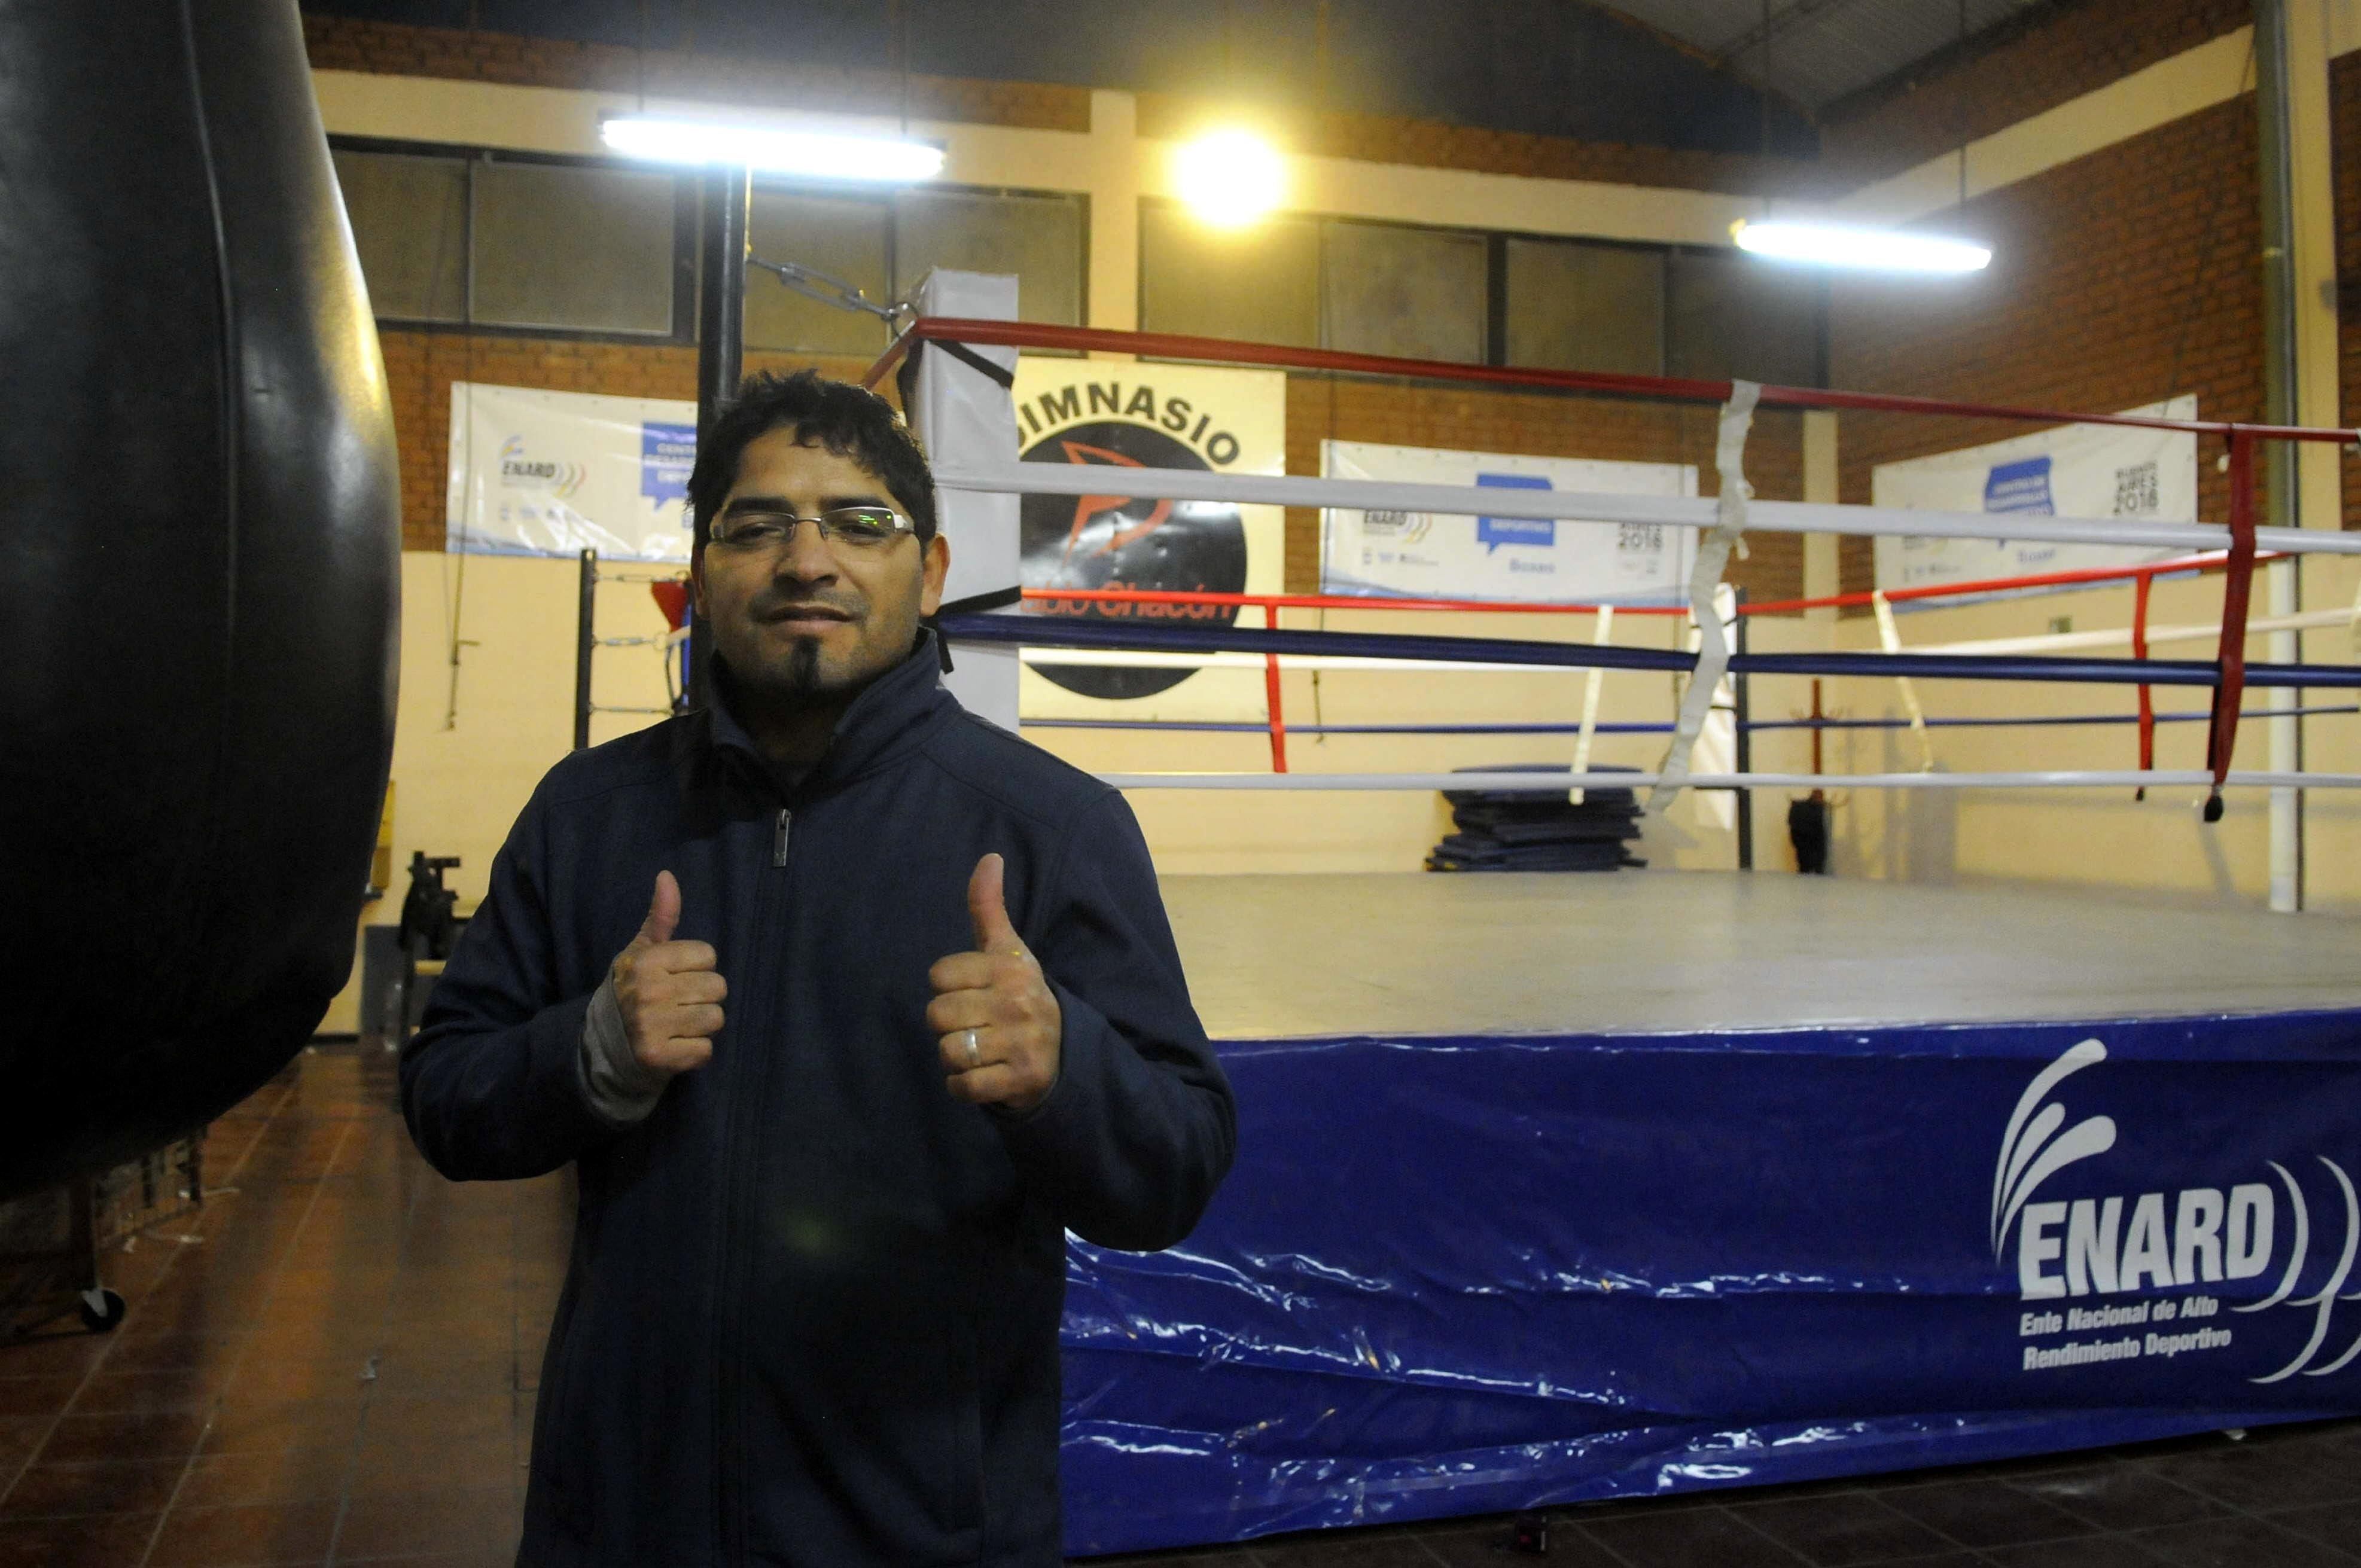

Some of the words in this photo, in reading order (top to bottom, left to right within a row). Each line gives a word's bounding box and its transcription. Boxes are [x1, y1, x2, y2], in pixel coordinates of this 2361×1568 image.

[1017, 381, 1241, 465] IMNASIO
[503, 460, 555, 478] ENARD
[2019, 1183, 2274, 1301] ENARD
[2019, 1311, 2063, 1337] Ente
[2066, 1300, 2150, 1331] Nacional
[2153, 1299, 2177, 1321] de
[2180, 1296, 2219, 1319] Alto
[2023, 1337, 2141, 1371] Rendimiento
[2144, 1327, 2232, 1357] Deportivo
